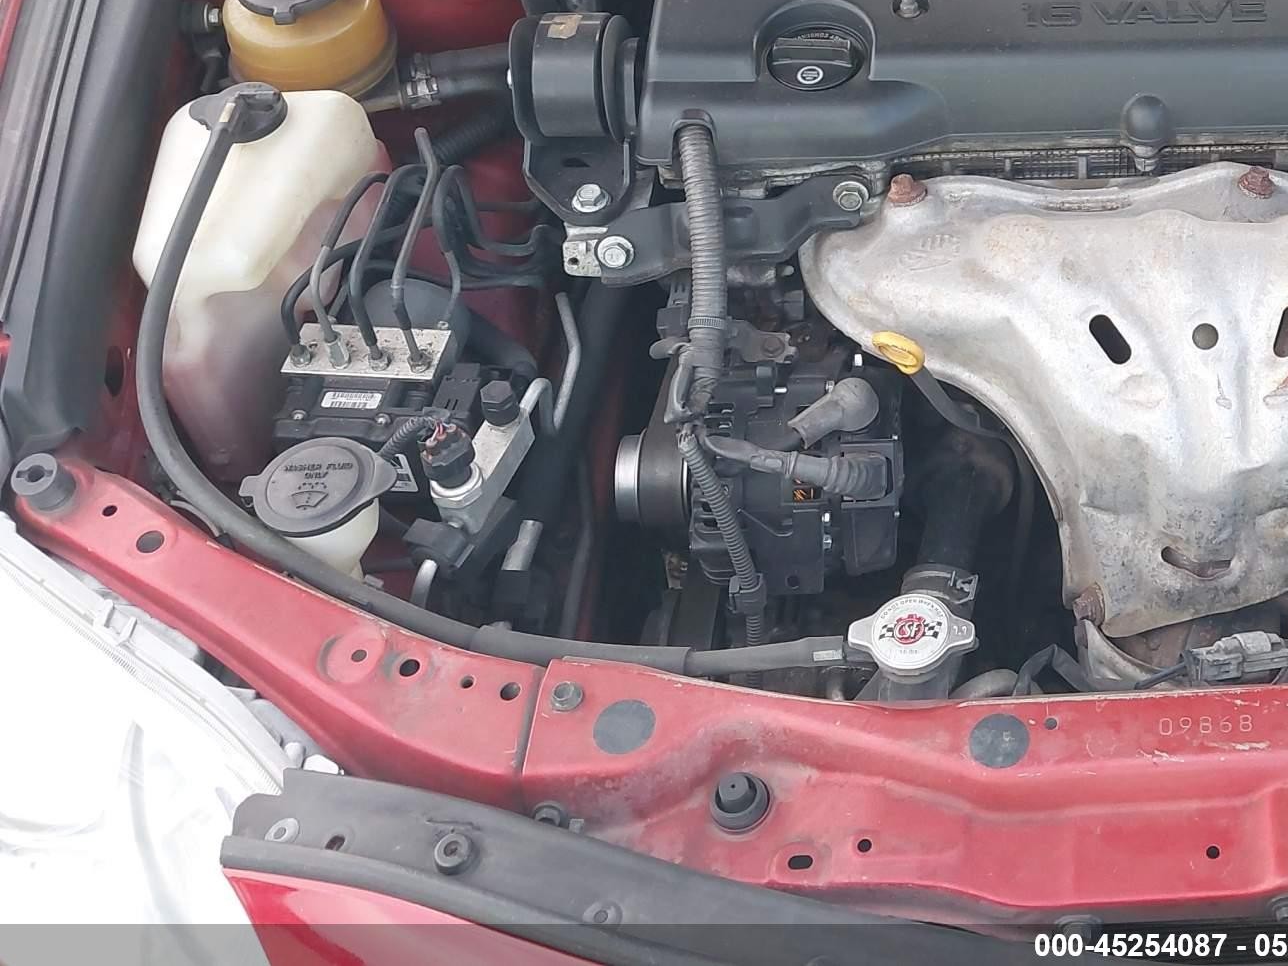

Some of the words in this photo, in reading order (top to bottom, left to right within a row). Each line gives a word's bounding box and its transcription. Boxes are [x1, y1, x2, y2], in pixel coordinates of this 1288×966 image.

[1020, 0, 1082, 28] 16
[1090, 0, 1267, 25] VALVE
[284, 463, 322, 474] WASHER
[326, 462, 353, 471] FLUID
[895, 620, 922, 639] CSF
[1159, 714, 1254, 736] 09868
